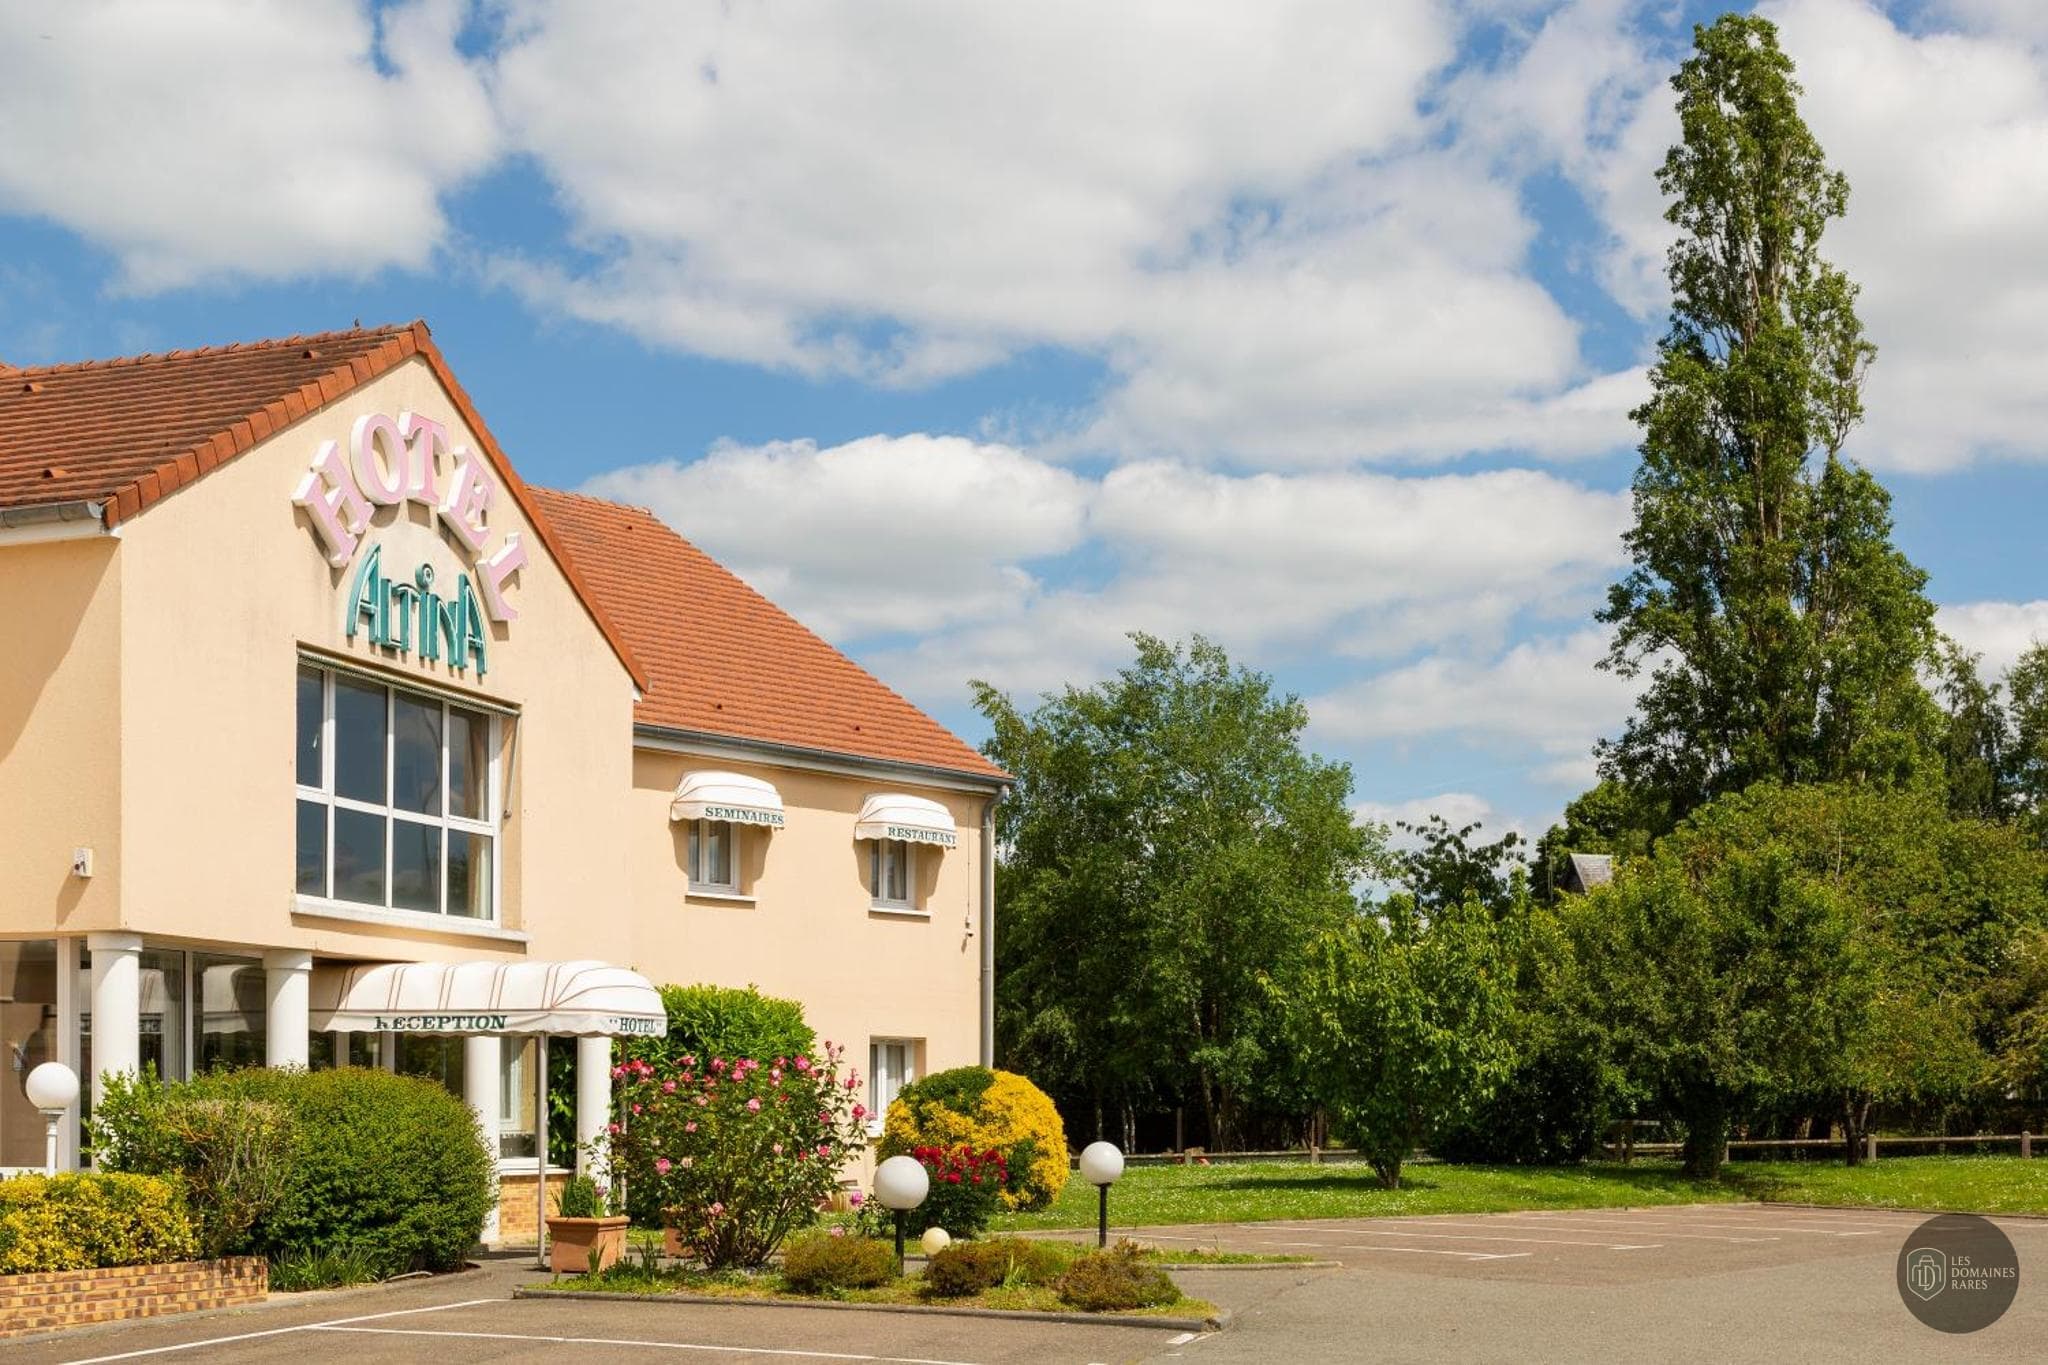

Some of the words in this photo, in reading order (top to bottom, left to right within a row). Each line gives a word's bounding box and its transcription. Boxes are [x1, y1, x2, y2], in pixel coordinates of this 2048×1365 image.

[292, 411, 528, 622] HOTEL
[705, 807, 784, 825] SEMINAIRES
[888, 826, 957, 845] RESTAURANT
